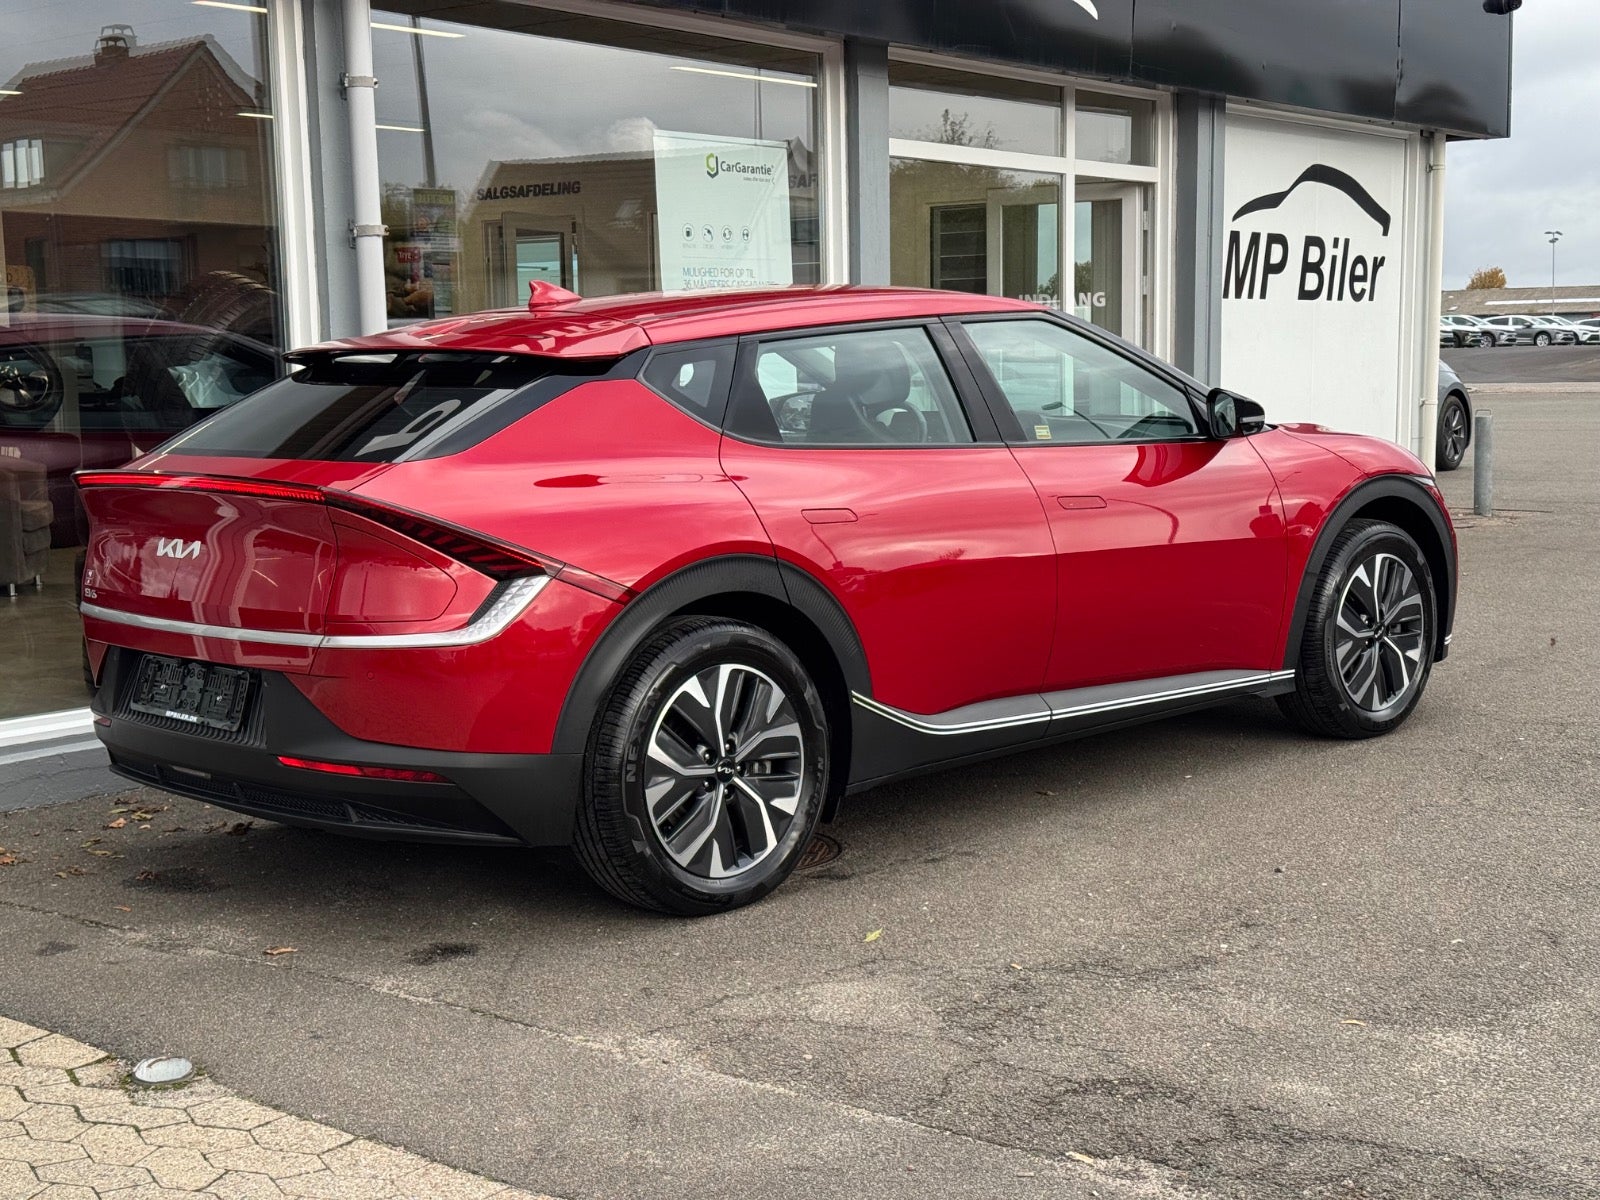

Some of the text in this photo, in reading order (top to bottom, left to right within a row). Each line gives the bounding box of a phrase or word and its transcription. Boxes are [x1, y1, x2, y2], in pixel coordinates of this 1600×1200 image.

[720, 161, 772, 176] CarGarantie
[477, 181, 581, 201] SALGSAFDELING
[683, 267, 756, 278] MULIGHED FOR OP TIL
[1222, 230, 1386, 303] MP Biler
[156, 536, 202, 560] KIA
